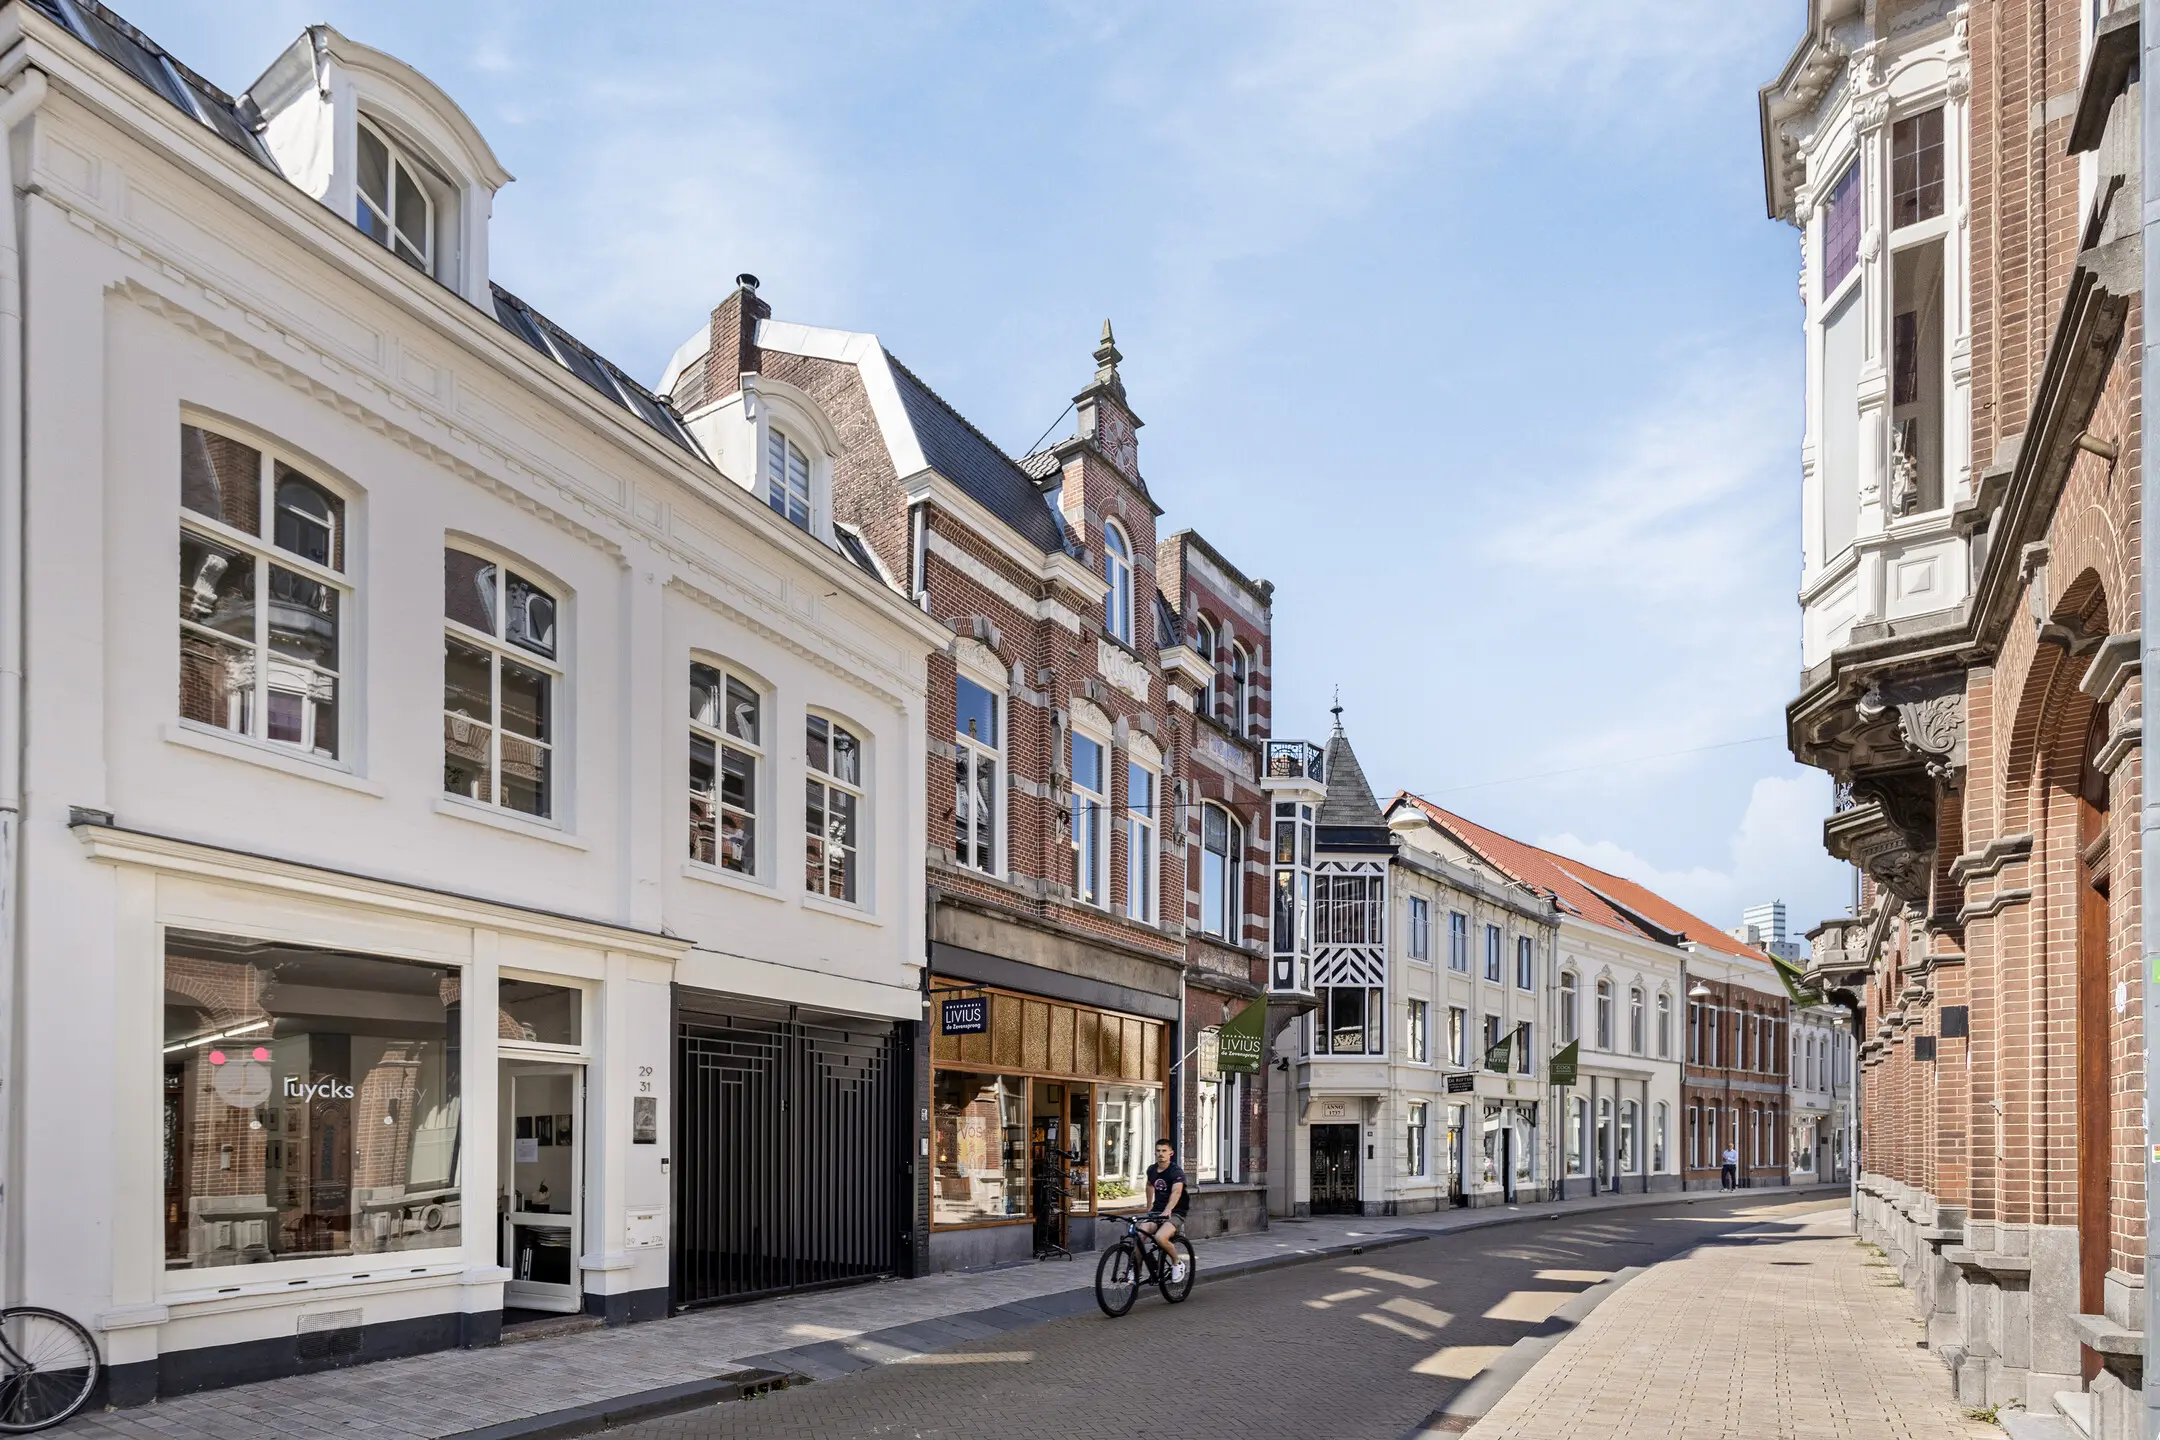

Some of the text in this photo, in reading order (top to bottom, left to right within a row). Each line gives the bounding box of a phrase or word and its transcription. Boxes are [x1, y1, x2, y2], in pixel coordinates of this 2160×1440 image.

[945, 1008, 981, 1023] LIVIUS
[1221, 1039, 1261, 1052] LIVIUS
[638, 1065, 653, 1077] 29
[283, 1076, 355, 1104] ruycks
[639, 1081, 652, 1092] 31
